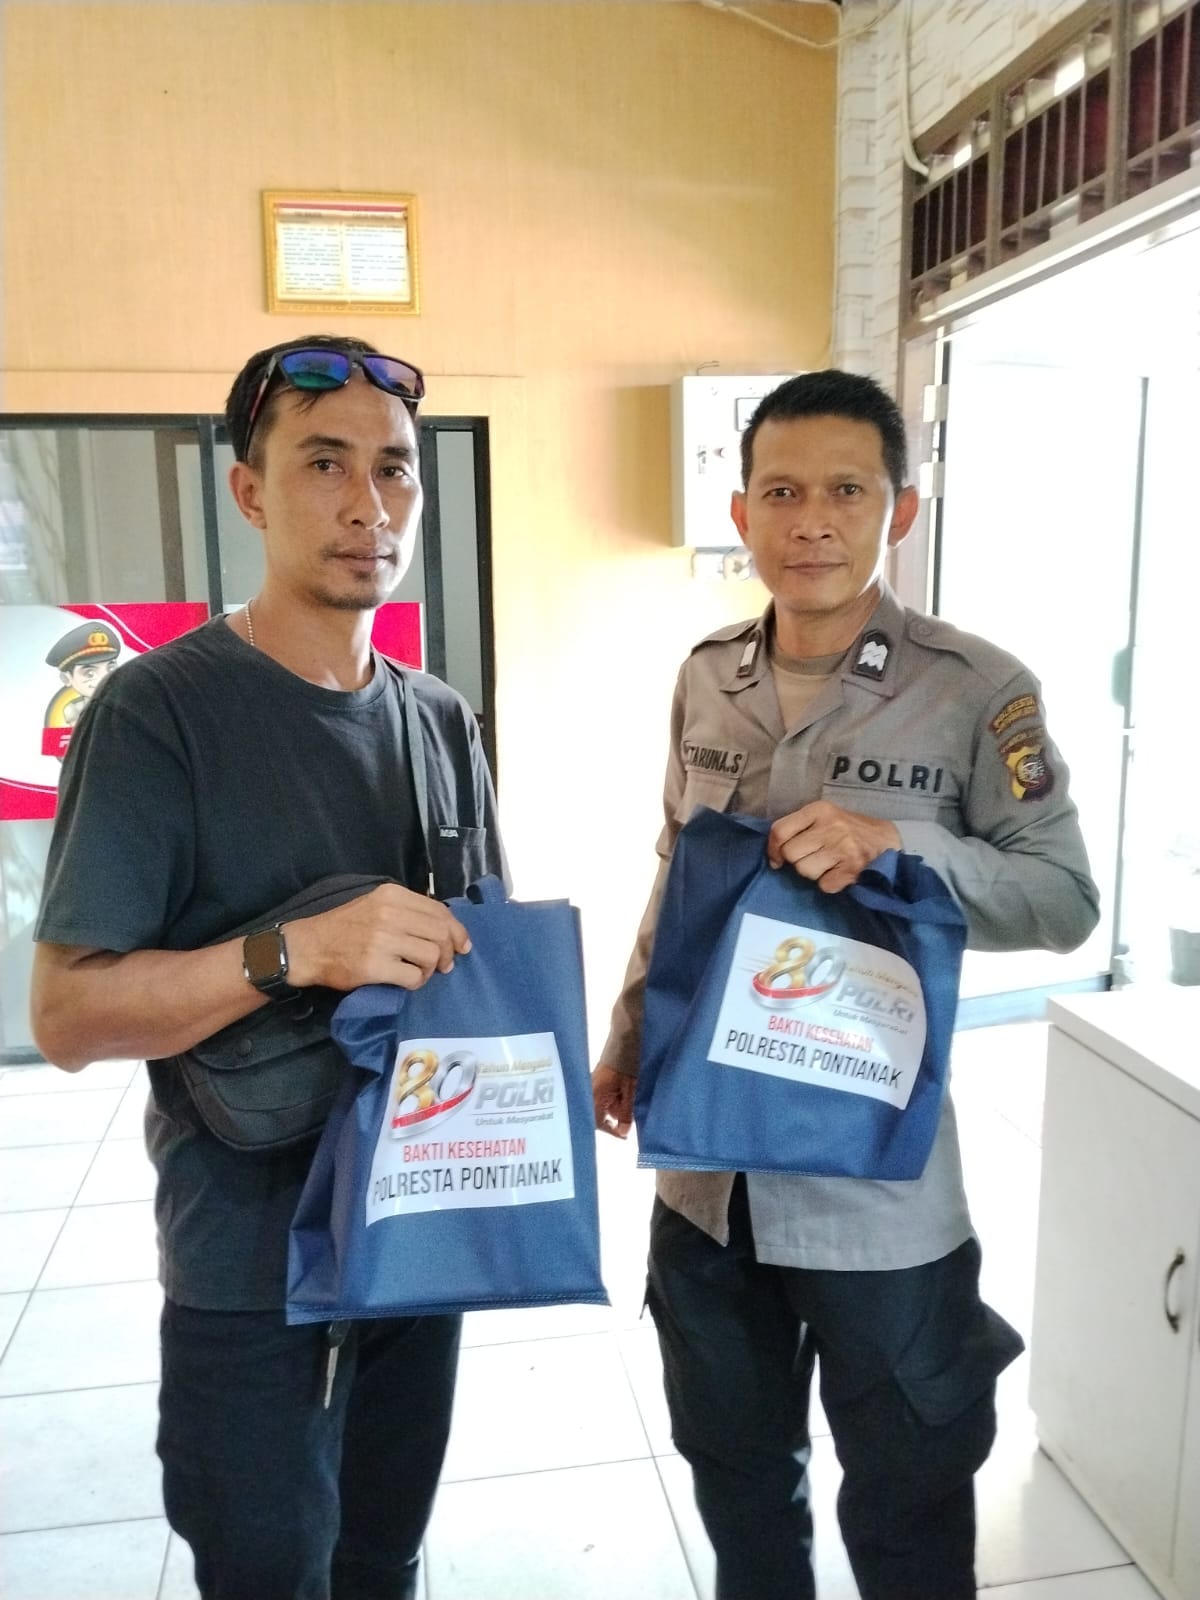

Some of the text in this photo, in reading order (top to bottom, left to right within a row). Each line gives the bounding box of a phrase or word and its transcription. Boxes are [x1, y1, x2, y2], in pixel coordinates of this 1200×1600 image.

[832, 756, 944, 793] POLRI
[753, 936, 846, 1005] 80
[836, 983, 914, 1022] POLRI
[768, 1015, 874, 1053] BAKTI KESEHATAN
[725, 1030, 902, 1088] POLRESTA PONTIANAK
[393, 1049, 478, 1131] 80
[475, 1077, 554, 1109] POLRI
[475, 1117, 503, 1126] Untuk
[403, 1138, 527, 1163] BAKTI KESEHATAN
[373, 1158, 562, 1205] POLRESTA PONTIANAK
